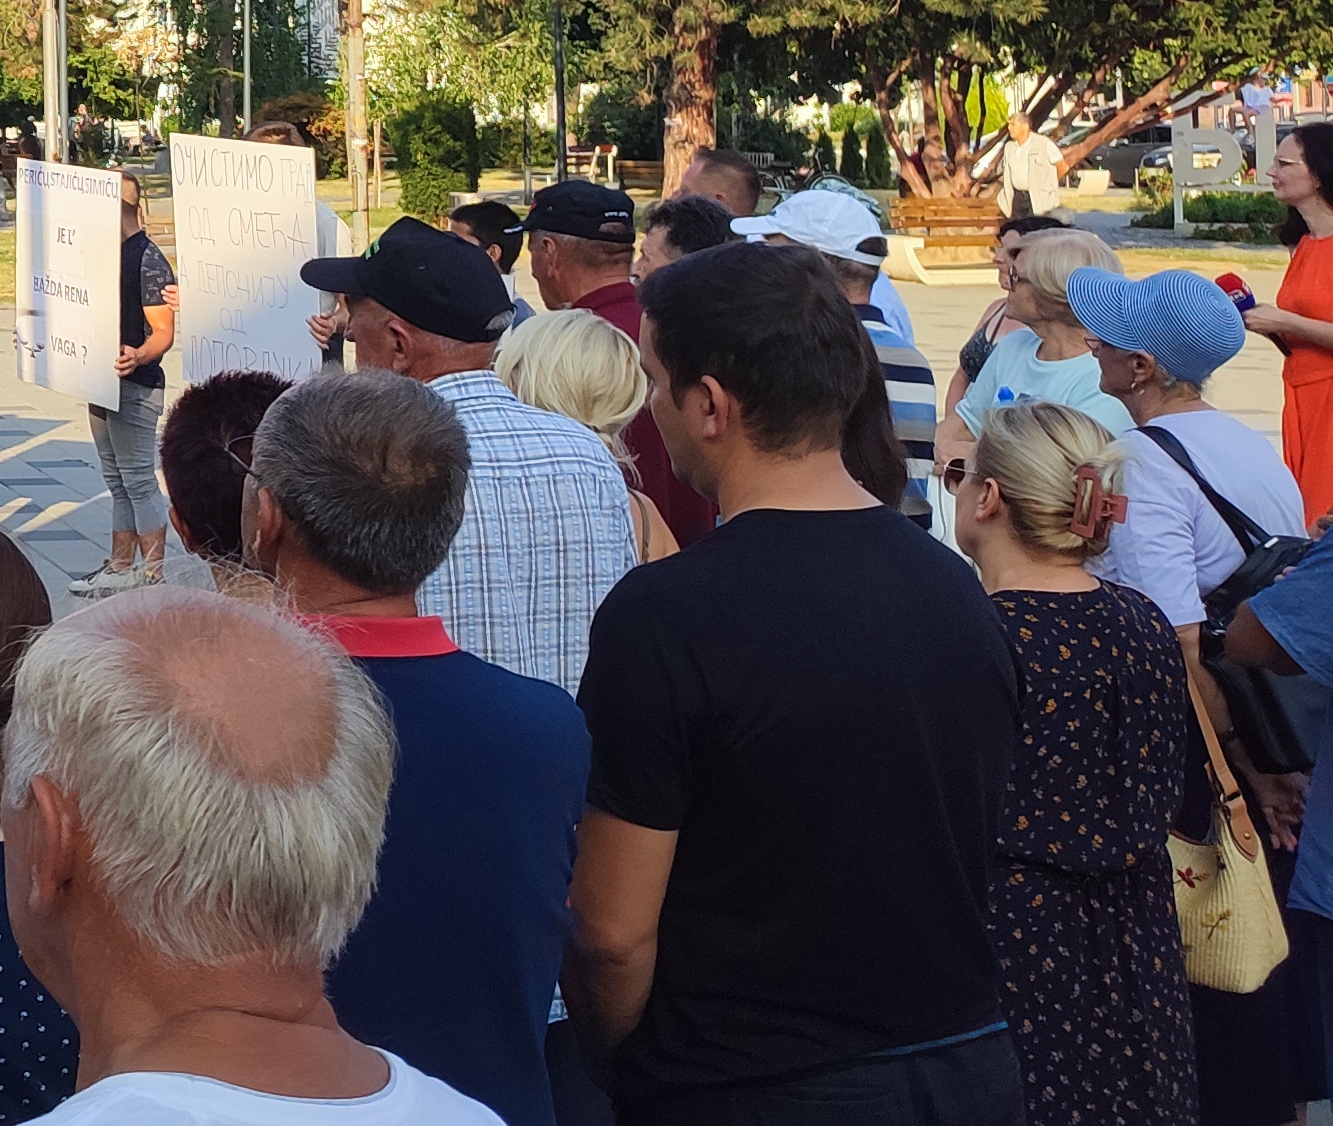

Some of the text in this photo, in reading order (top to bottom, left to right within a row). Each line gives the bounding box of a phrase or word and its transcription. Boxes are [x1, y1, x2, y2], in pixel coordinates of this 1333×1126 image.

[173, 142, 316, 205] ОЧИСТИМО ГРАД
[188, 205, 216, 246] ОД
[179, 254, 190, 289] А
[219, 306, 247, 336] ОД
[50, 335, 77, 358] VAGA
